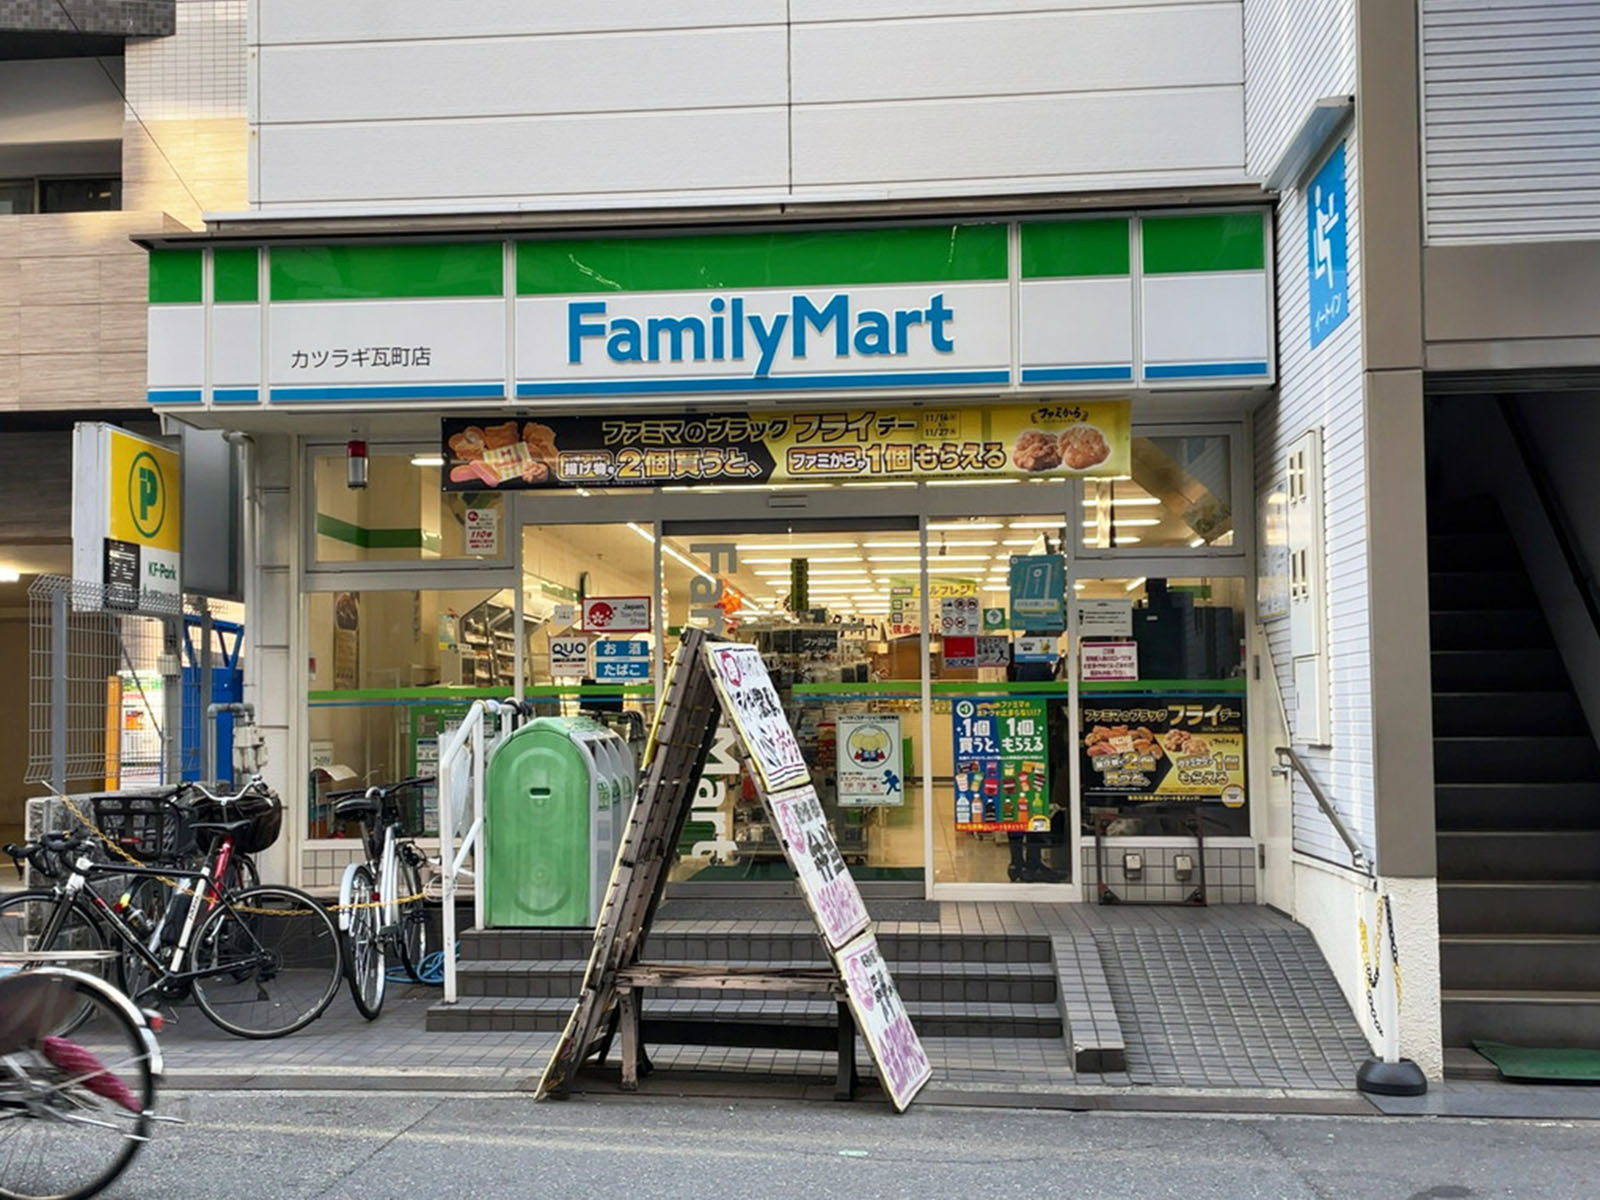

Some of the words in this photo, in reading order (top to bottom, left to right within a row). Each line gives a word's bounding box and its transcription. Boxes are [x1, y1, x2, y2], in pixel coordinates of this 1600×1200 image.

[567, 294, 954, 378] FamilyMart
[290, 346, 432, 369] カツラギ瓦町店
[552, 642, 586, 657] QUO
[604, 642, 641, 655] お酒
[604, 664, 640, 676] たばこ
[963, 718, 990, 737] 1個
[1006, 718, 1034, 737] 1個
[1002, 736, 1044, 753] もらえる
